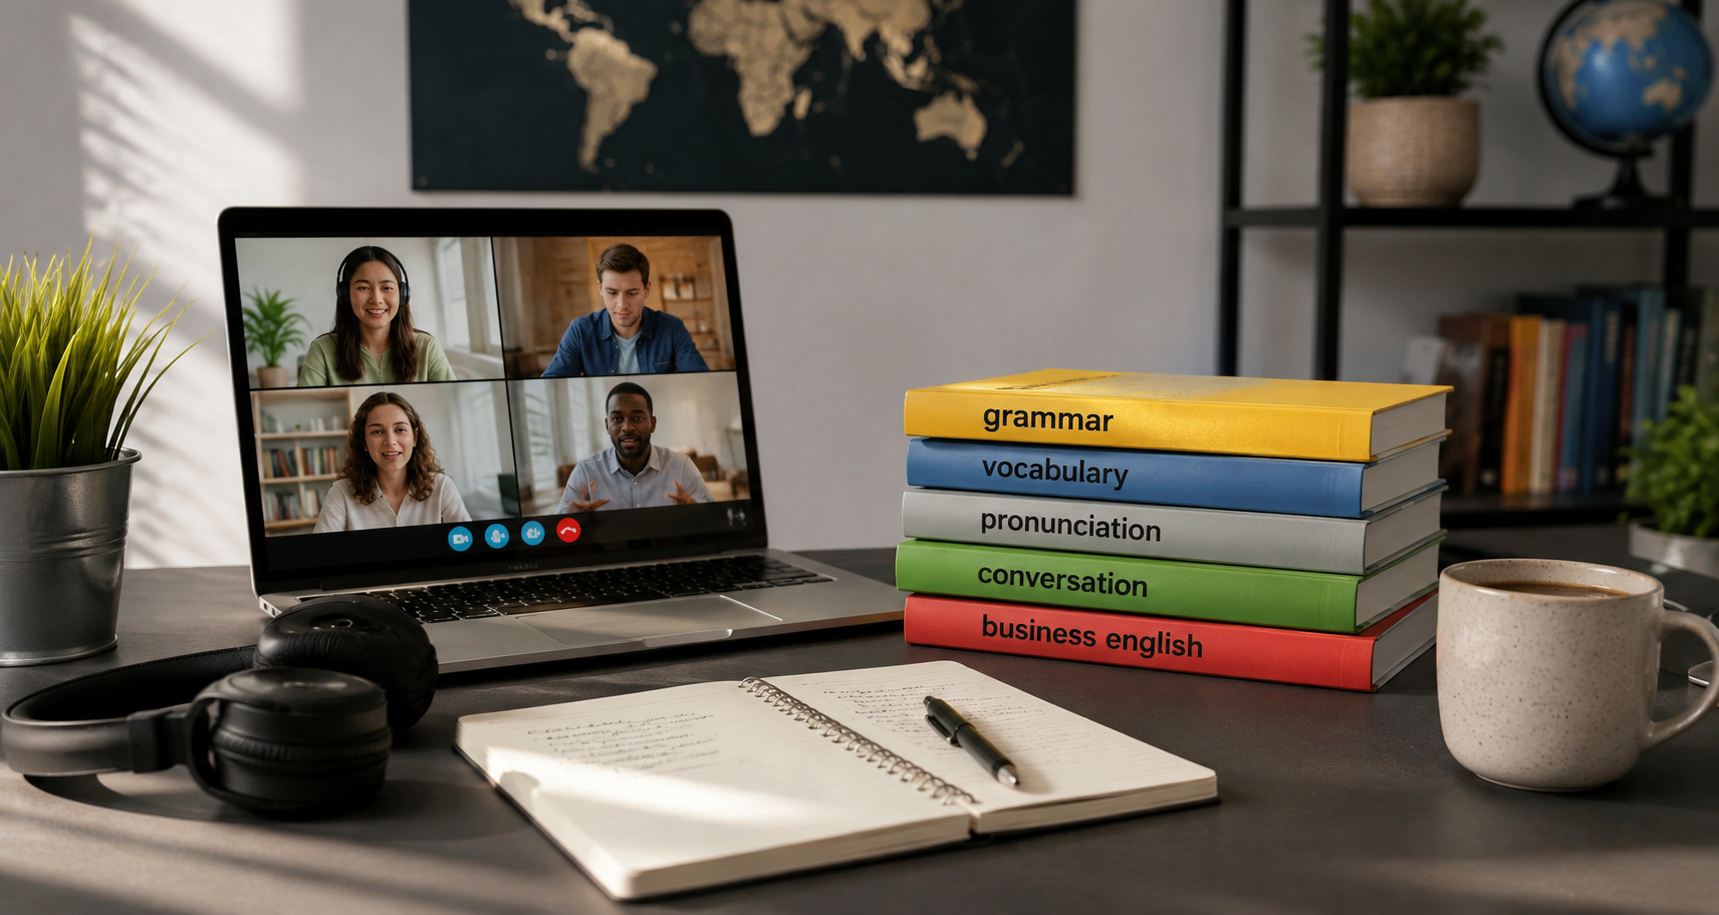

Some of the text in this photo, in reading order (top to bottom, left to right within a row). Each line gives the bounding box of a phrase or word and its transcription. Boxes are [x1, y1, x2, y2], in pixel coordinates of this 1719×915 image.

[983, 408, 1114, 433] grammar
[982, 457, 1129, 491] vocabulary
[981, 512, 1160, 542] pronunciation
[977, 567, 1148, 597] conversation
[982, 613, 1203, 659] business english
